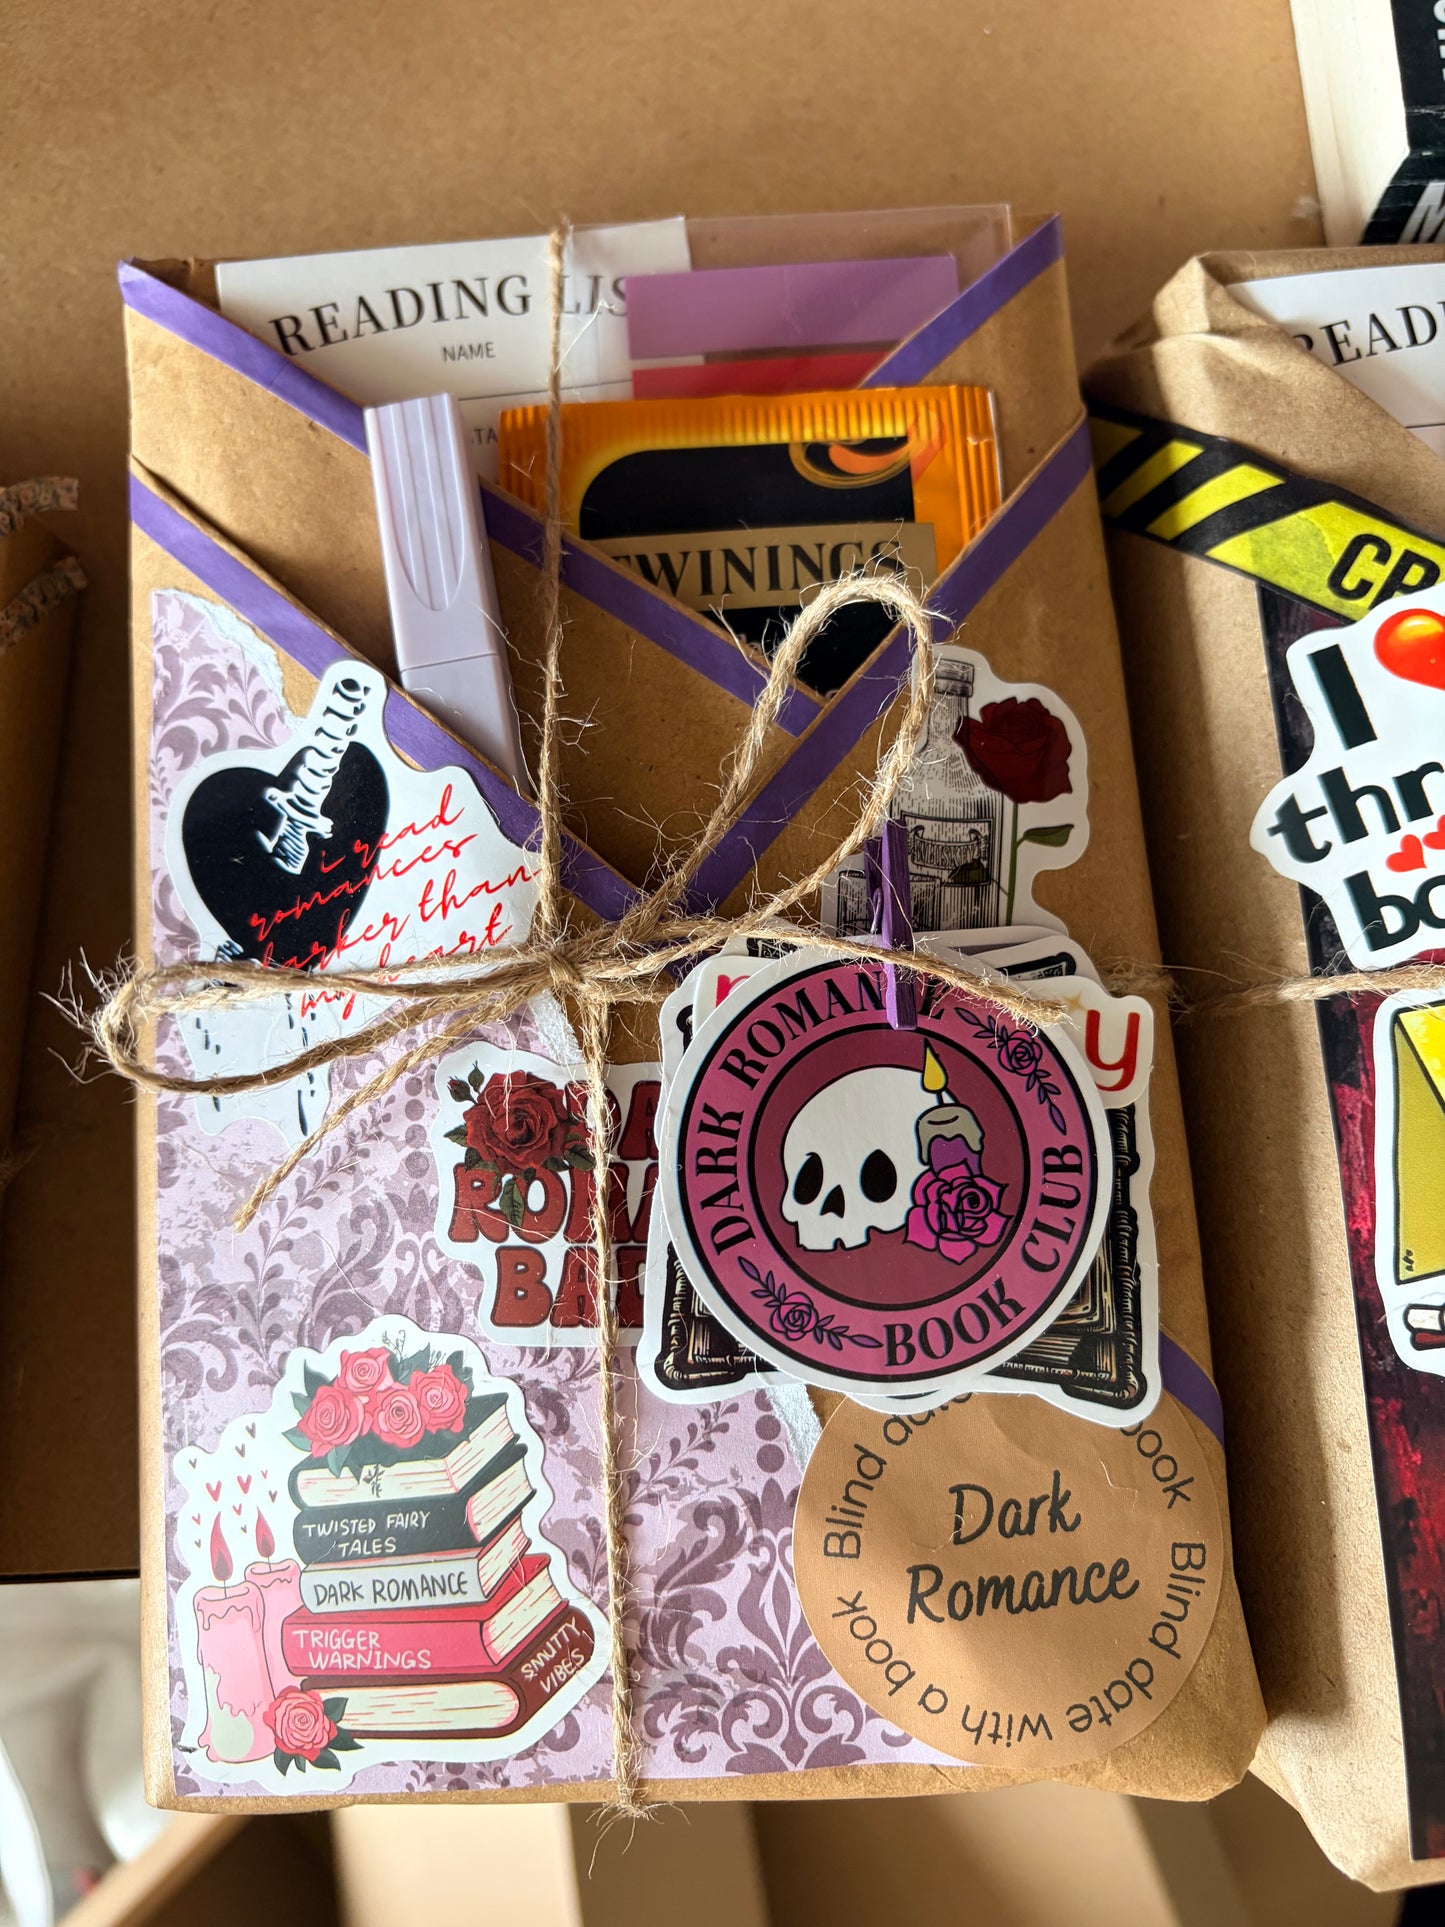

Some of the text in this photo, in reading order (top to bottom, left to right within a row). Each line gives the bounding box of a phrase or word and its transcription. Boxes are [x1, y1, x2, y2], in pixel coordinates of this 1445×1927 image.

[268, 274, 628, 357] READING LIS
[1292, 300, 1445, 368] EAD
[441, 341, 496, 363] NAME
[1307, 643, 1378, 751] I
[320, 783, 466, 874] i read
[250, 833, 478, 942] romances
[418, 864, 544, 923] than
[376, 902, 514, 984] hart
[696, 968, 948, 1256] DARK ROMANE
[883, 1143, 1084, 1368] BOOK CLUB
[823, 1391, 975, 1560] Blind da
[948, 1469, 1082, 1546] Dark
[302, 1510, 431, 1540] TWISTED FAIRY
[337, 1536, 397, 1558] TALES
[313, 1570, 469, 1607] DARK ROMANCE
[905, 1556, 1141, 1626] Romance
[292, 1628, 381, 1650] TRIGGER
[308, 1649, 432, 1671] WARNINGS
[520, 1616, 582, 1683] SMUTTY
[539, 1647, 586, 1694] VIBES
[831, 1540, 1208, 1748] Blind date with a book
